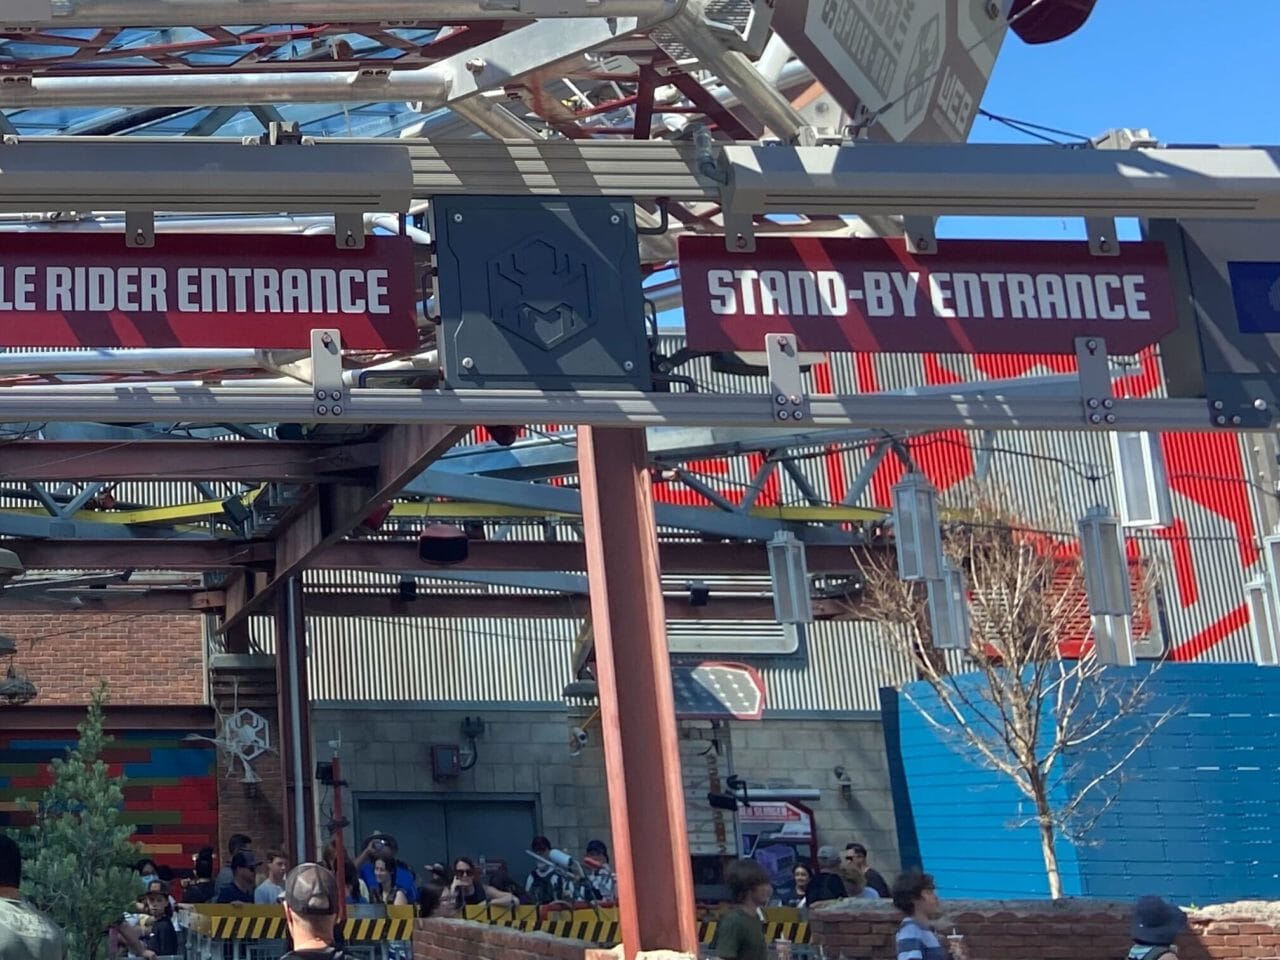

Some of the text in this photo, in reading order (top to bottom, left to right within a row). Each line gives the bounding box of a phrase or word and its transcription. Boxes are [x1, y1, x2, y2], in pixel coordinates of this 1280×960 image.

[833, 3, 896, 97] SPIDER-MAN
[937, 65, 973, 135] WEB
[46, 266, 167, 312] RIDER
[177, 267, 390, 314] ENTRANCE
[707, 269, 1151, 320] STAND-BY ENTRANCE
